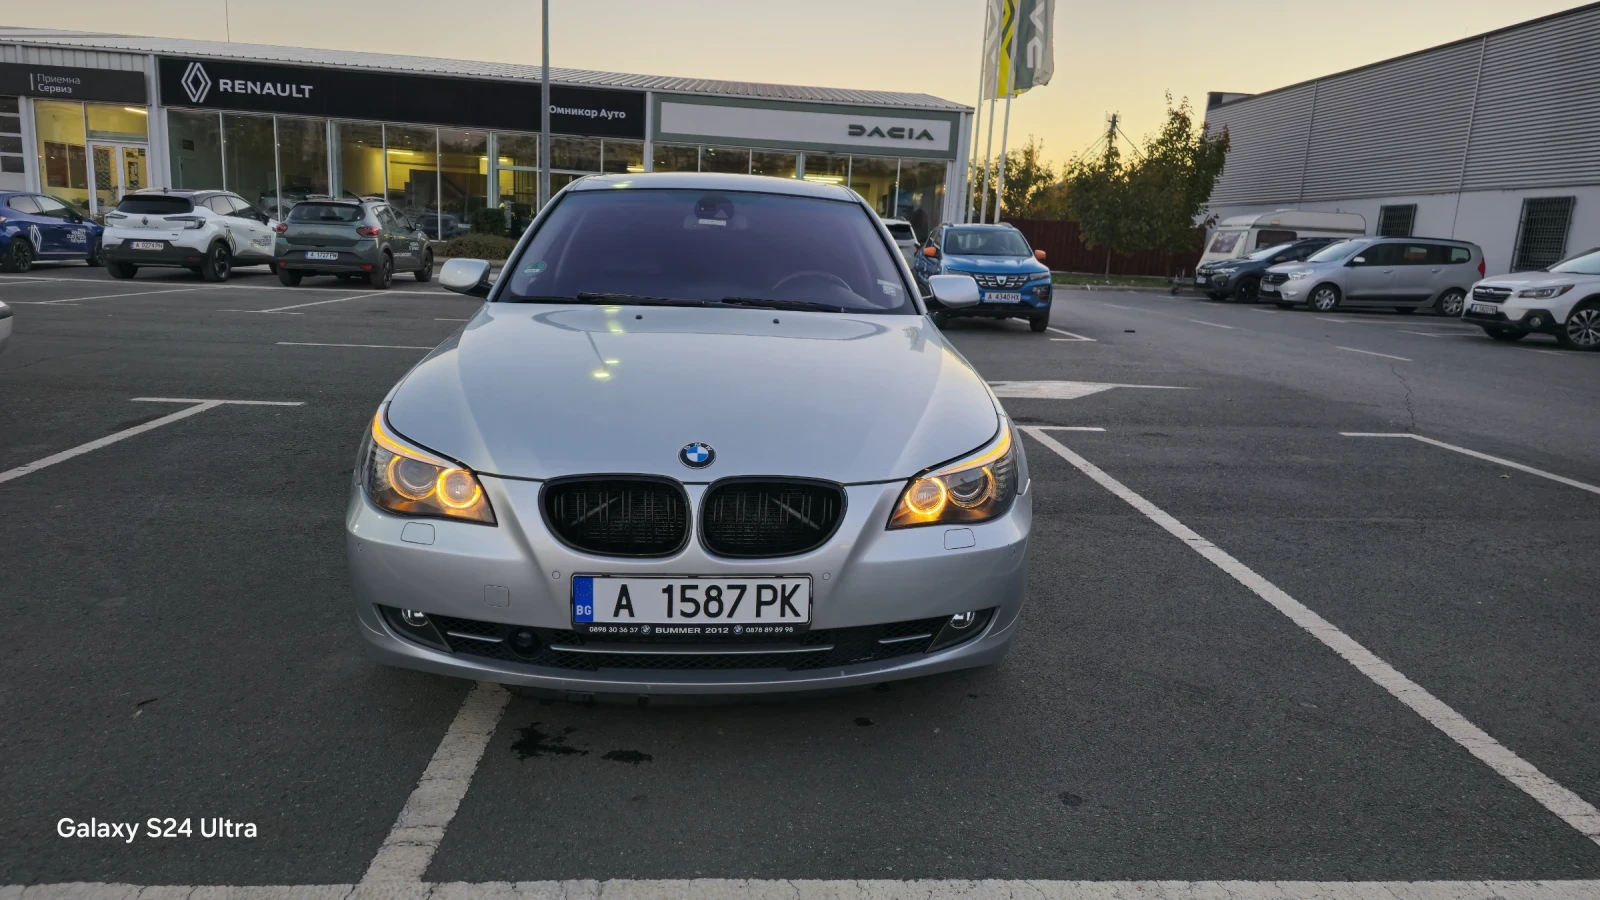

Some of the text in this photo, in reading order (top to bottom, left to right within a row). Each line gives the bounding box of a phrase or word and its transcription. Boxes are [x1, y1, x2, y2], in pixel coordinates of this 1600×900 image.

[37, 73, 81, 85] Приемна
[37, 83, 73, 94] Сервиз
[219, 79, 314, 99] RENAULT
[549, 105, 627, 120] Омникар Ауто
[848, 123, 935, 141] DACIA
[612, 584, 802, 619] A 1587 PK
[576, 605, 592, 616] BG
